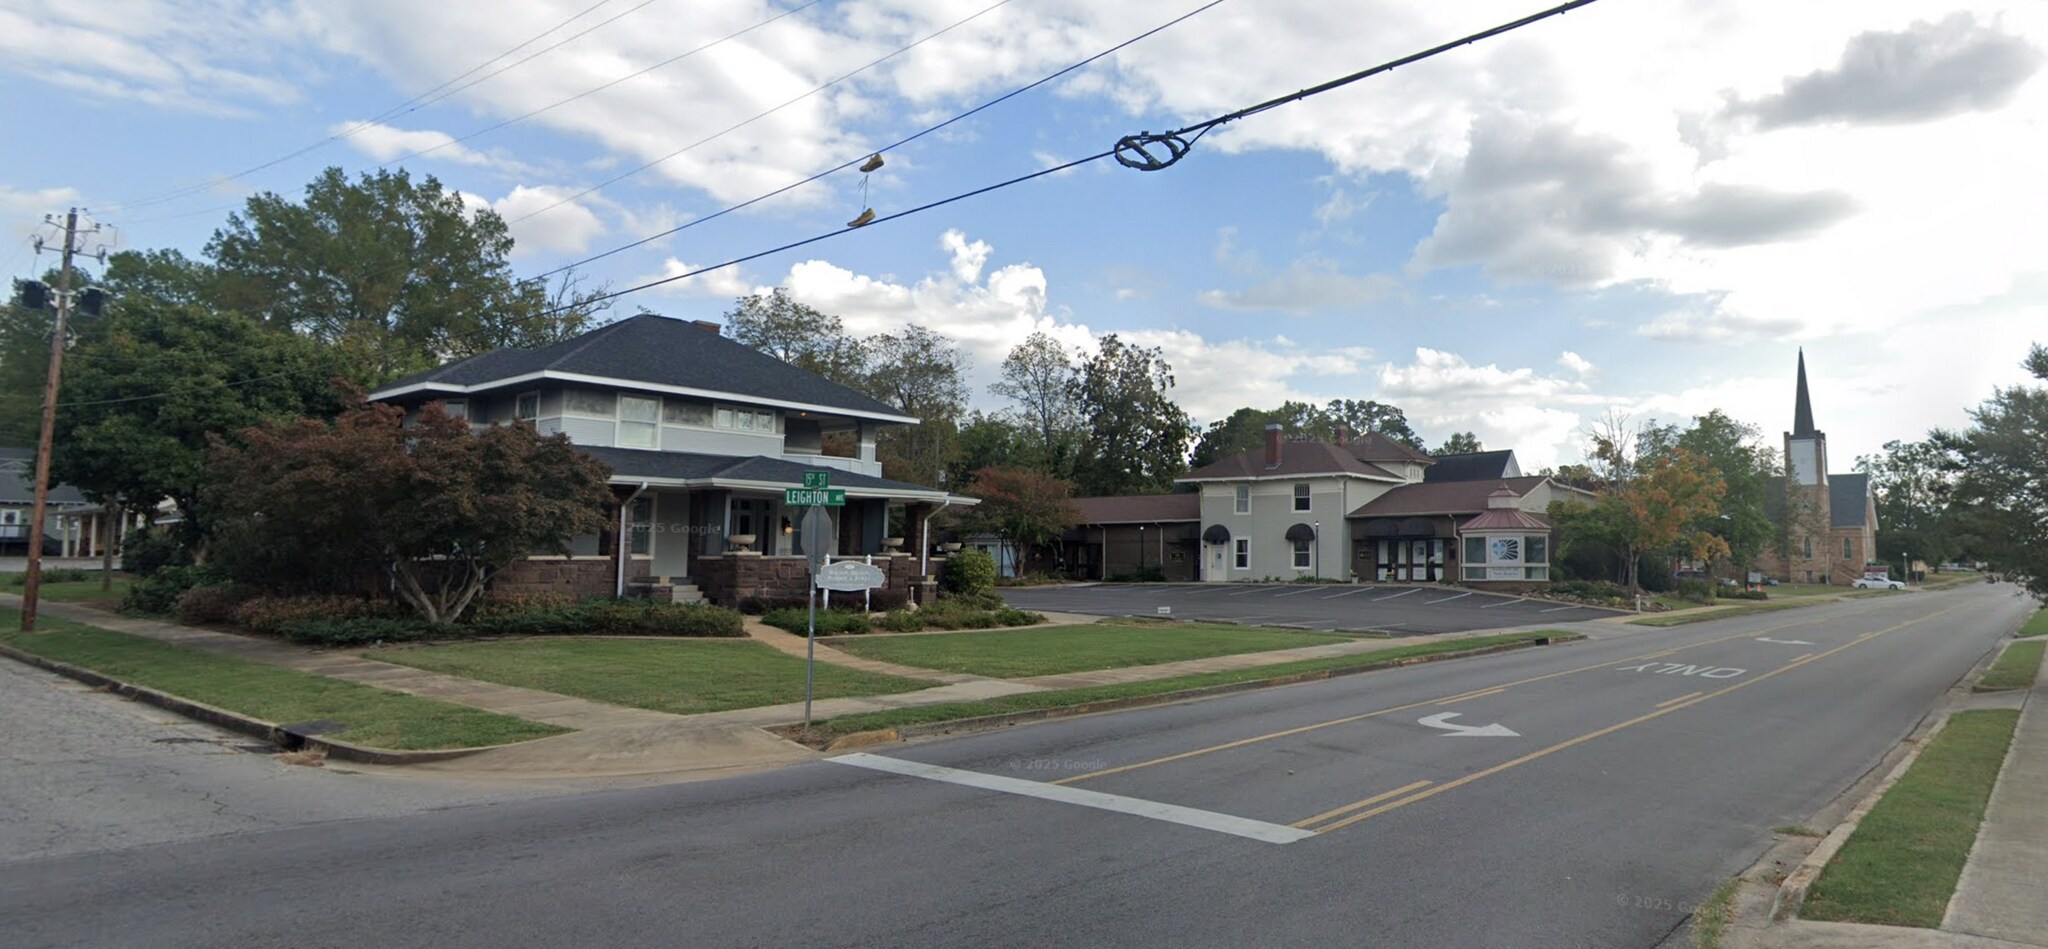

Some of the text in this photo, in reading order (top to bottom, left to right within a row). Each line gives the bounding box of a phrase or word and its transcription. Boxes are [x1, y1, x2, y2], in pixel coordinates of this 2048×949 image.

[818, 473, 826, 487] ST
[786, 490, 829, 504] LEIGHTON
[1616, 662, 1748, 679] ONLY
